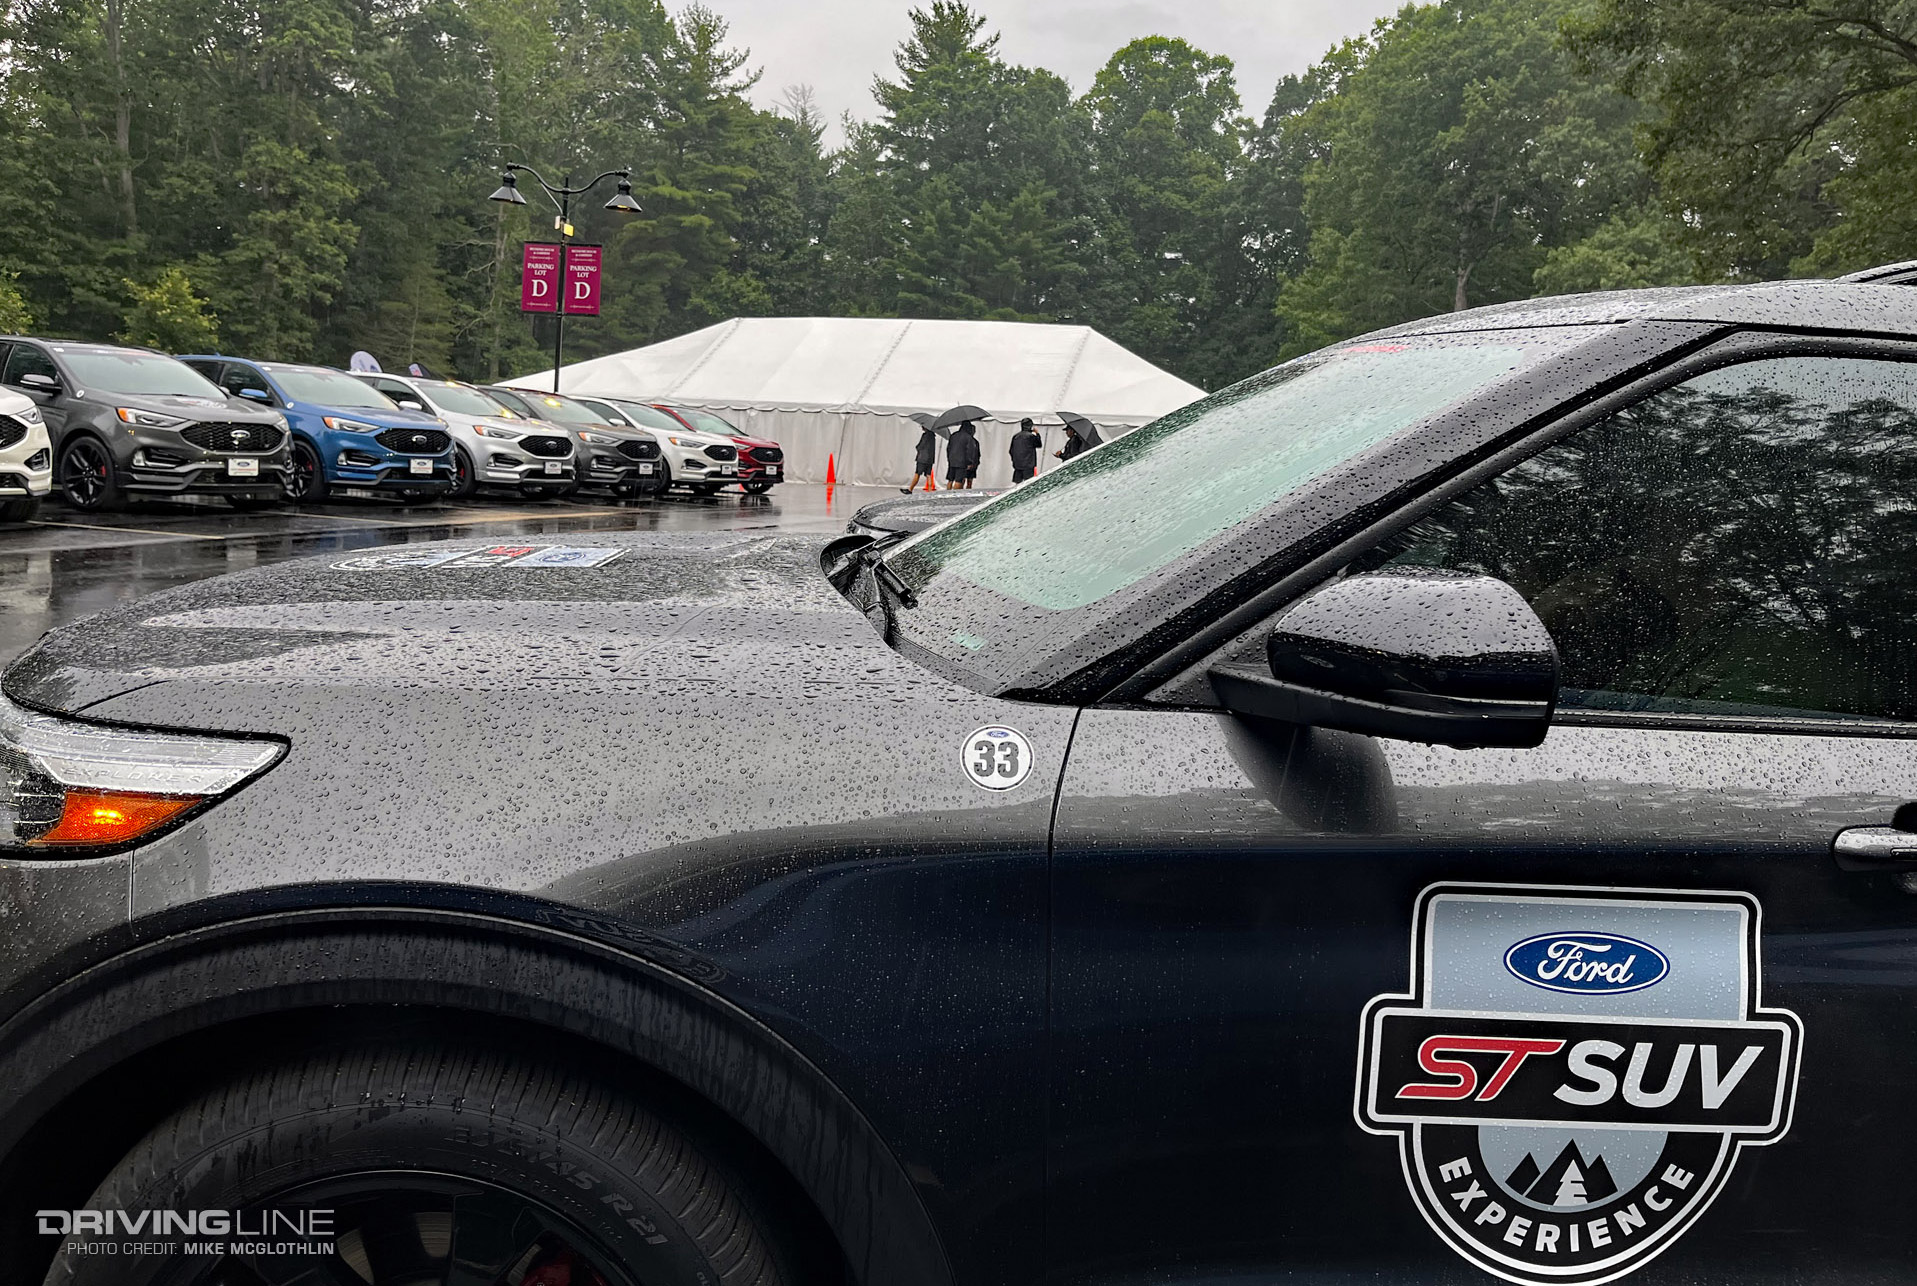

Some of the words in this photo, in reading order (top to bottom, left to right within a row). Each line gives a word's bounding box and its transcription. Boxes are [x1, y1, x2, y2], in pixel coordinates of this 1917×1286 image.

[527, 262, 554, 270] PARKING
[531, 279, 548, 297] D
[574, 281, 591, 299] D
[973, 740, 1019, 778] 33
[62, 766, 205, 784] EXPLORER
[1536, 940, 1637, 984] Ford
[1394, 1034, 1567, 1102] ST
[1553, 1039, 1765, 1109] SUV
[1438, 1156, 1695, 1253] EXPERIENCE
